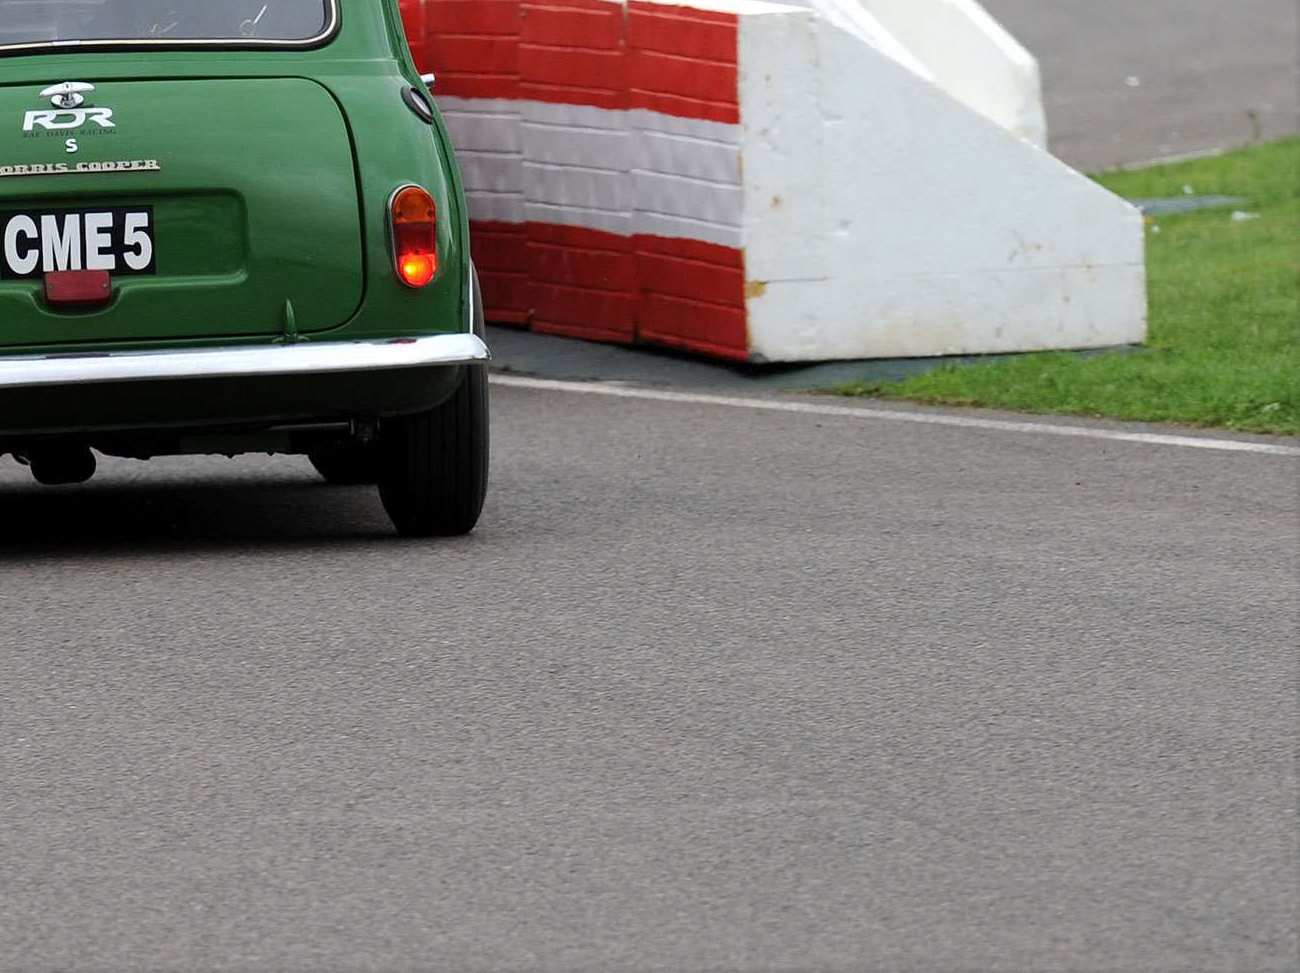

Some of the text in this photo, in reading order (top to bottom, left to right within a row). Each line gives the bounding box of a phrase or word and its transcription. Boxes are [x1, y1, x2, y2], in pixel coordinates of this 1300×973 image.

[23, 108, 116, 131] RDR
[65, 138, 78, 153] S
[76, 159, 159, 172] COOPER
[4, 212, 153, 275] CME 5
